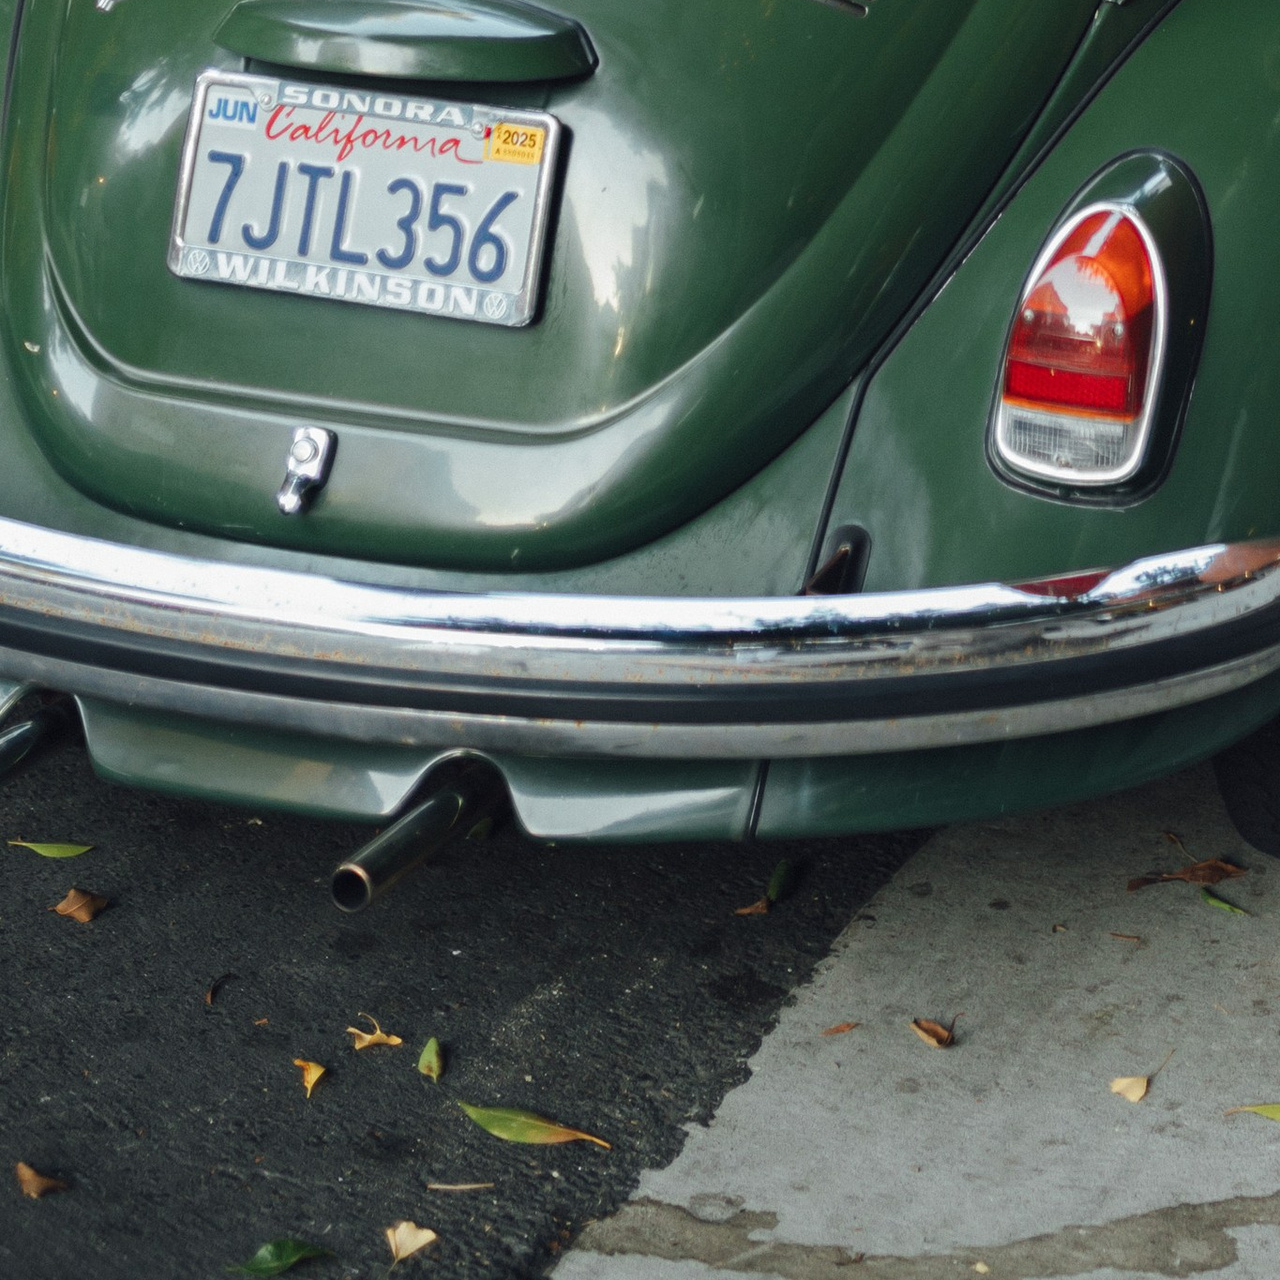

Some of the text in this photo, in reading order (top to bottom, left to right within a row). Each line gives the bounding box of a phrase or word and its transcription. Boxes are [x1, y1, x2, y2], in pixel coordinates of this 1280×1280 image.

[208, 97, 258, 125] JUN
[283, 86, 465, 126] SONORA
[265, 104, 484, 164] California
[502, 129, 537, 149] 2025
[206, 149, 519, 283] 7JTL356
[217, 252, 478, 316] WILKINSON
